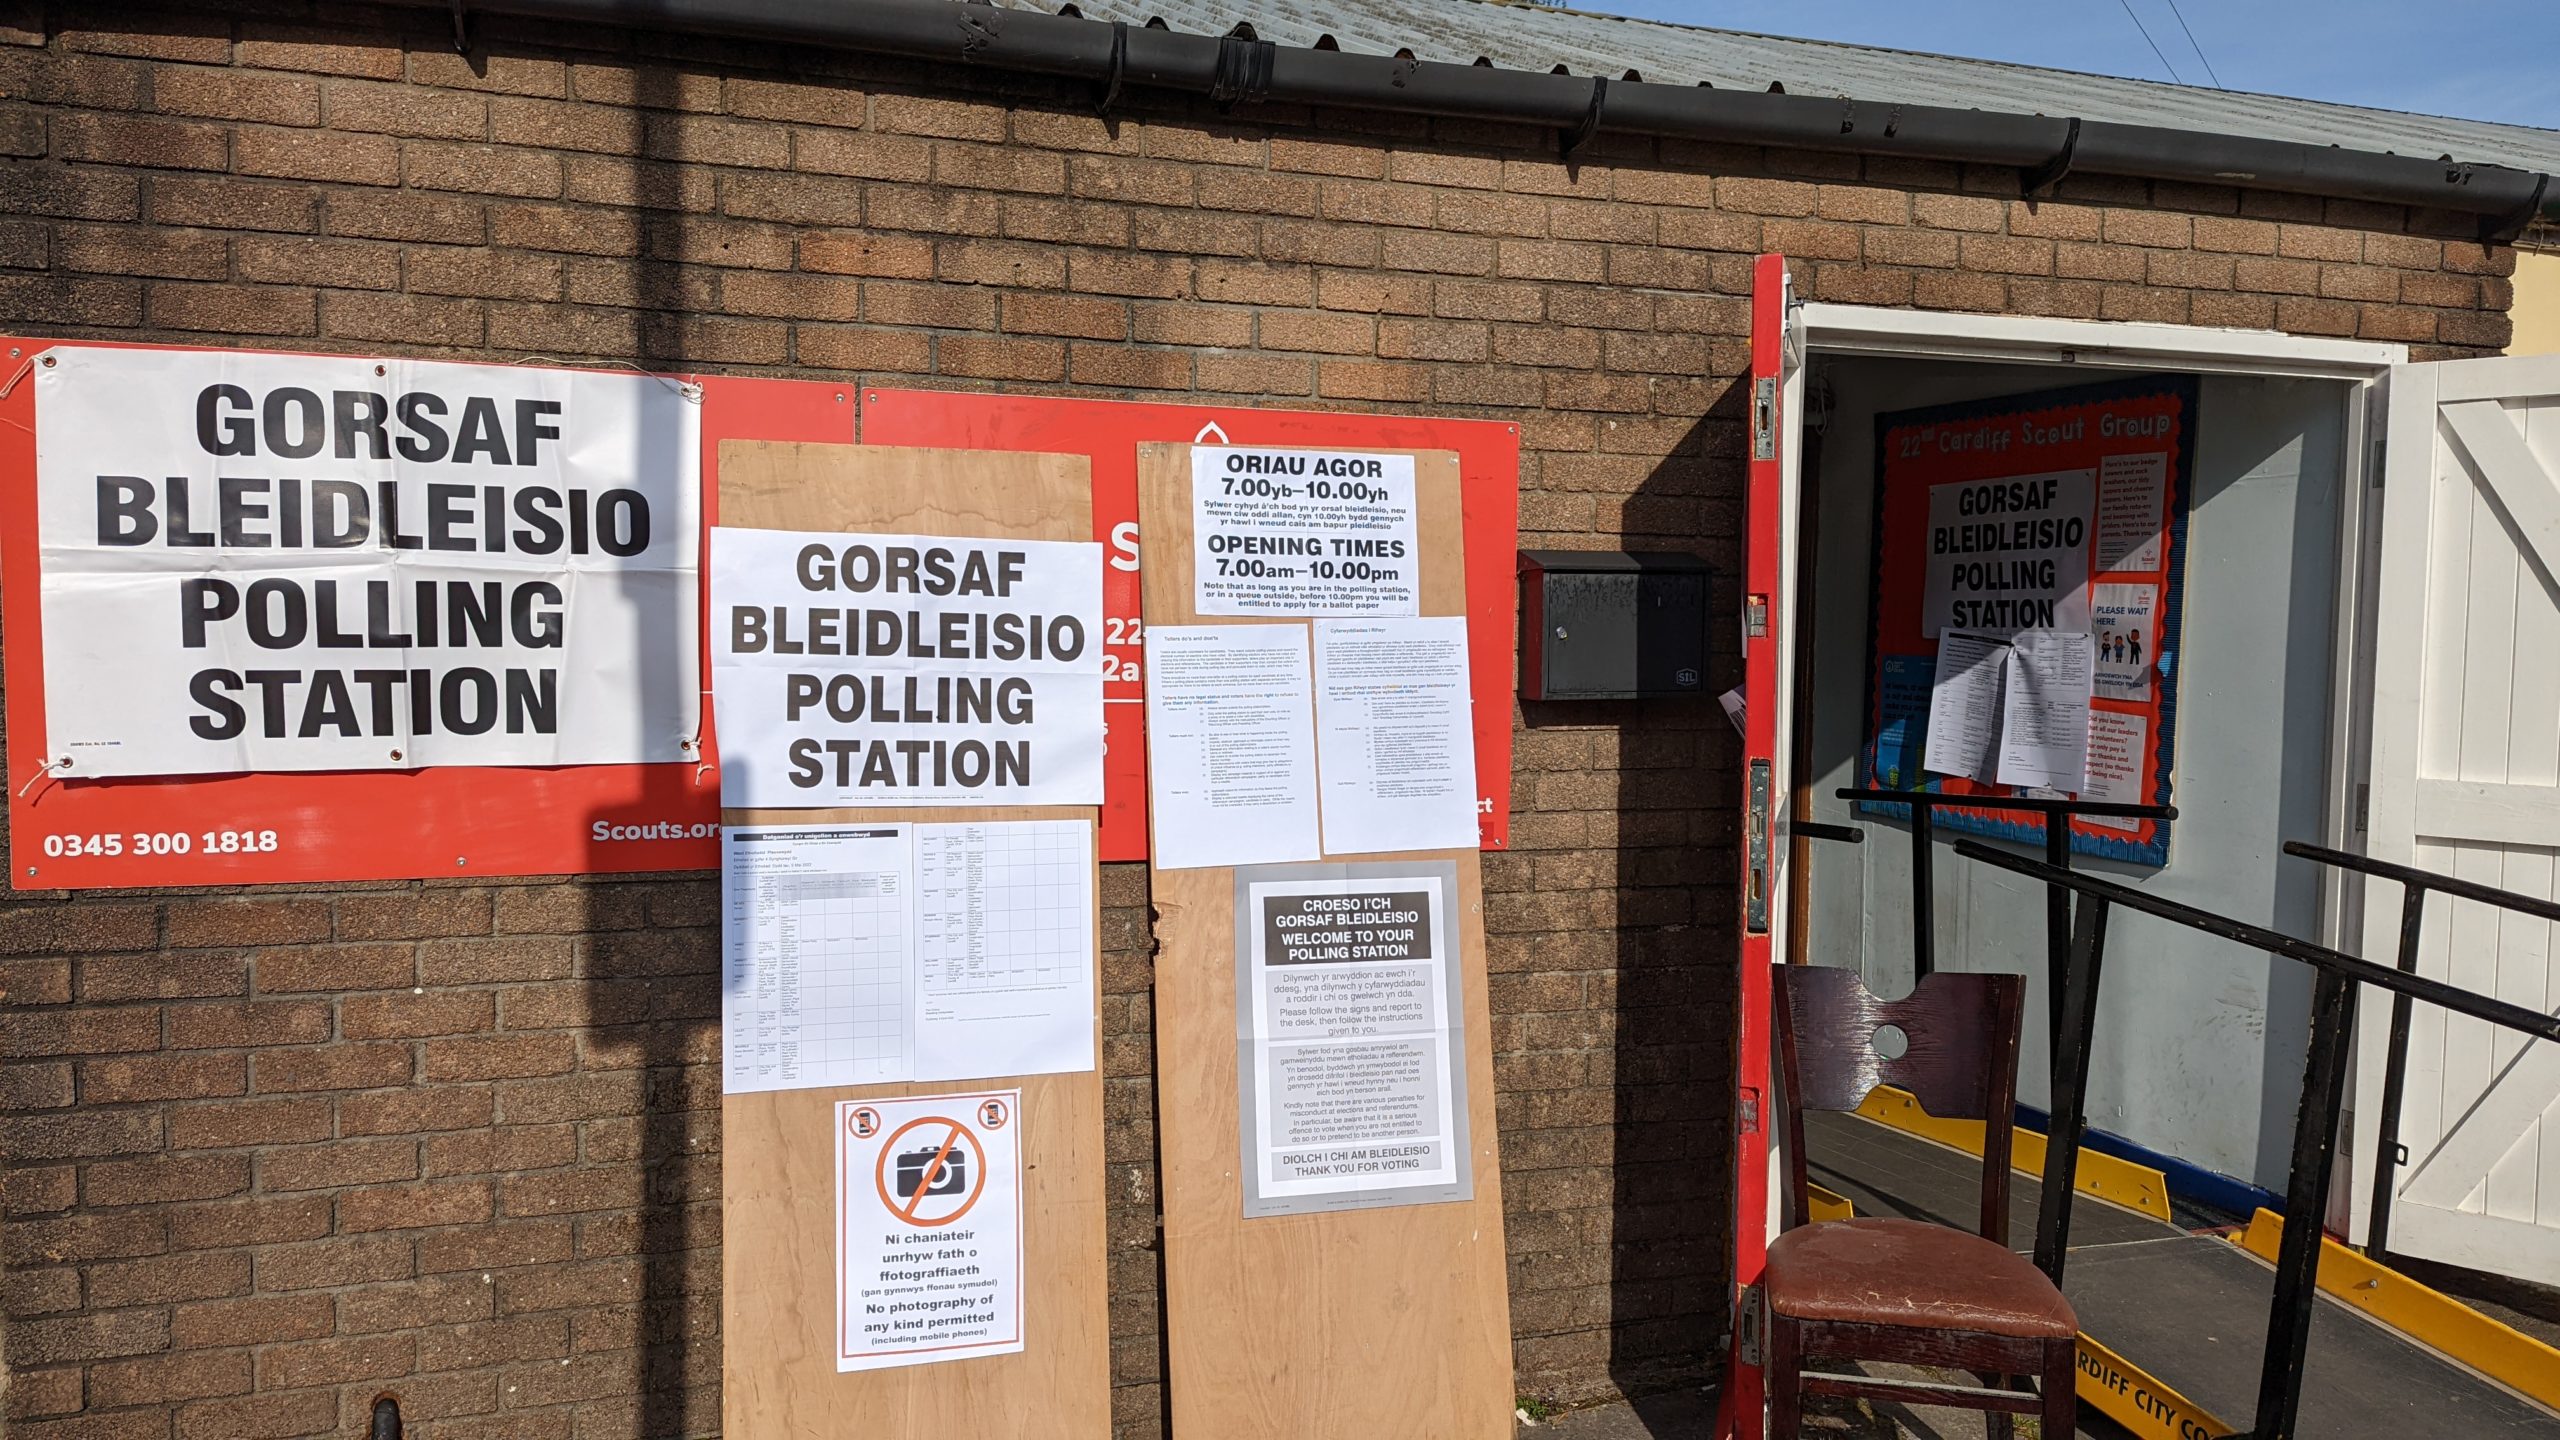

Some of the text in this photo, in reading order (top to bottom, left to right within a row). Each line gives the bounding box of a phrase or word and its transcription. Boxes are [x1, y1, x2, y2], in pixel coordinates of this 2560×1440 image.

[196, 384, 561, 466] GORSAF
[1940, 427, 2011, 452] Cardiff
[2022, 418, 2084, 444] Scout
[2101, 412, 2170, 438] Group
[1226, 454, 1382, 478] ORIAU AGOR
[1203, 499, 1232, 509] Sylwer
[1233, 501, 1259, 511] cyhyd
[1310, 505, 1319, 513] yr
[1320, 504, 1343, 512] orsaf
[1344, 505, 1389, 515] bleidleisio,
[1959, 480, 2058, 516] GORSAF
[97, 476, 650, 556] BLEIDLEISIO
[1206, 509, 1404, 523] mewn ciw oddi allan, cyn 10.00yh bydd gennych
[1219, 518, 1228, 526] yr
[1230, 517, 1251, 526] hawl
[1257, 519, 1287, 527] wneud
[1288, 519, 1306, 527] cais
[1322, 520, 1348, 530] bapur
[1349, 521, 1392, 530] pleidleisio
[1934, 517, 2084, 554] BLEIDLEISIO
[1208, 534, 1405, 558] OPENING TIMES
[796, 543, 1025, 597] GORSAF
[1952, 559, 2056, 591] POLLING
[1203, 581, 1224, 589] Note
[1226, 582, 1244, 590] that
[1257, 583, 1276, 592] long
[1323, 584, 1332, 592] in
[1333, 584, 1348, 592] the
[1348, 585, 1377, 594] polling
[1378, 586, 1411, 594] station,
[1217, 590, 1226, 598] in
[1235, 592, 1262, 600] queue
[1263, 592, 1298, 600] outside,
[1299, 592, 1326, 600] before
[1328, 592, 1364, 602] 10.00pm
[1364, 594, 1380, 602] you
[1398, 594, 1409, 602] be
[181, 578, 562, 649] POLLING
[1237, 599, 1270, 607] entitled
[1271, 600, 1281, 608] to
[1282, 600, 1307, 609] apply
[1308, 600, 1320, 608] for
[1355, 602, 1380, 610] paper
[1952, 599, 2054, 629] STATION
[2096, 606, 2149, 616] PLEASE WAIT
[2096, 616, 2116, 626] HERE
[731, 605, 1084, 662] BLEIDLEISIO
[189, 667, 556, 740] STATION
[786, 673, 1033, 725] POLLING
[788, 738, 1030, 788] STATION
[592, 820, 721, 841] Scouts.or
[44, 830, 278, 856] 0345 300 1818
[1302, 897, 1361, 912] CROESO
[1275, 910, 1419, 928] GORSAF BLEIDLEISIO
[1281, 928, 1414, 946] WELCOME TO YOUR
[1288, 943, 1408, 961] POLLING STATION
[1273, 978, 1426, 995] ddesg, yna dilynwch y cyfarwyddiadau
[1282, 972, 1320, 984] Dilynwch
[1320, 973, 1330, 983] yr
[1331, 970, 1373, 982] arwyddion
[1373, 971, 1384, 979] ac
[1385, 969, 1407, 978] ewch
[1279, 1002, 1422, 1017] Please follow the signs and report to
[1279, 1011, 1423, 1027] the desk, then follow the instructions
[1282, 1152, 1322, 1165] DIOLCH
[1329, 1151, 1348, 1162] CHI
[1350, 1149, 1367, 1160] AM
[1368, 1144, 1430, 1159] BLEIDLEISIO
[1294, 1158, 1420, 1176] THANK YOU FOR VOTING
[885, 1229, 975, 1245] Ni chaniateir
[882, 1247, 978, 1264] unrhyw fath o
[879, 1264, 980, 1282] ffotograffiaeth
[860, 1278, 998, 1298] (gan gynnwys ffonau symudol)
[866, 1293, 994, 1315] No photography of
[863, 1311, 994, 1334] any kind permitted
[871, 1327, 987, 1346] (including mobile phones)
[2077, 1352, 2130, 1395] RDIFF
[2135, 1390, 2178, 1427] CITY
